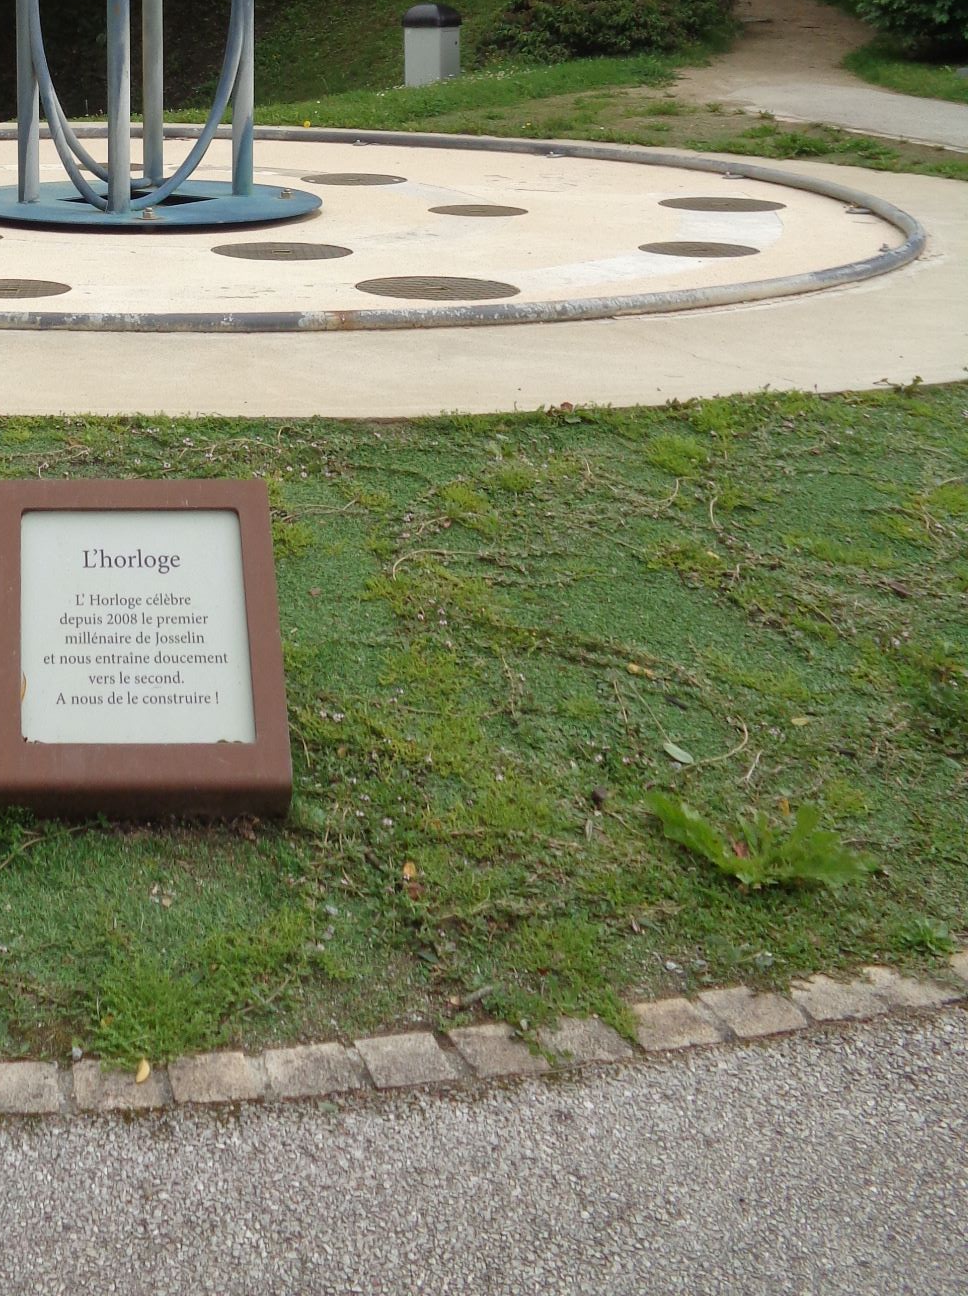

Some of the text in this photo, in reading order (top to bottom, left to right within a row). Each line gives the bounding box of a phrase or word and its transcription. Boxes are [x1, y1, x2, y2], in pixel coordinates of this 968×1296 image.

[82, 549, 181, 575] L'horloge
[89, 593, 143, 610] Horloge
[145, 593, 192, 606] célèbre
[59, 612, 209, 629] depuis 2008 le premier
[65, 631, 205, 647] millénaire de Josselin
[43, 654, 56, 665] et
[59, 656, 92, 665] nous
[153, 651, 229, 665] doucement
[88, 671, 185, 685] vers le second.
[55, 693, 67, 705] A
[71, 696, 104, 705] nous
[107, 691, 124, 705] de
[127, 691, 139, 705] le
[142, 692, 211, 705] construire
